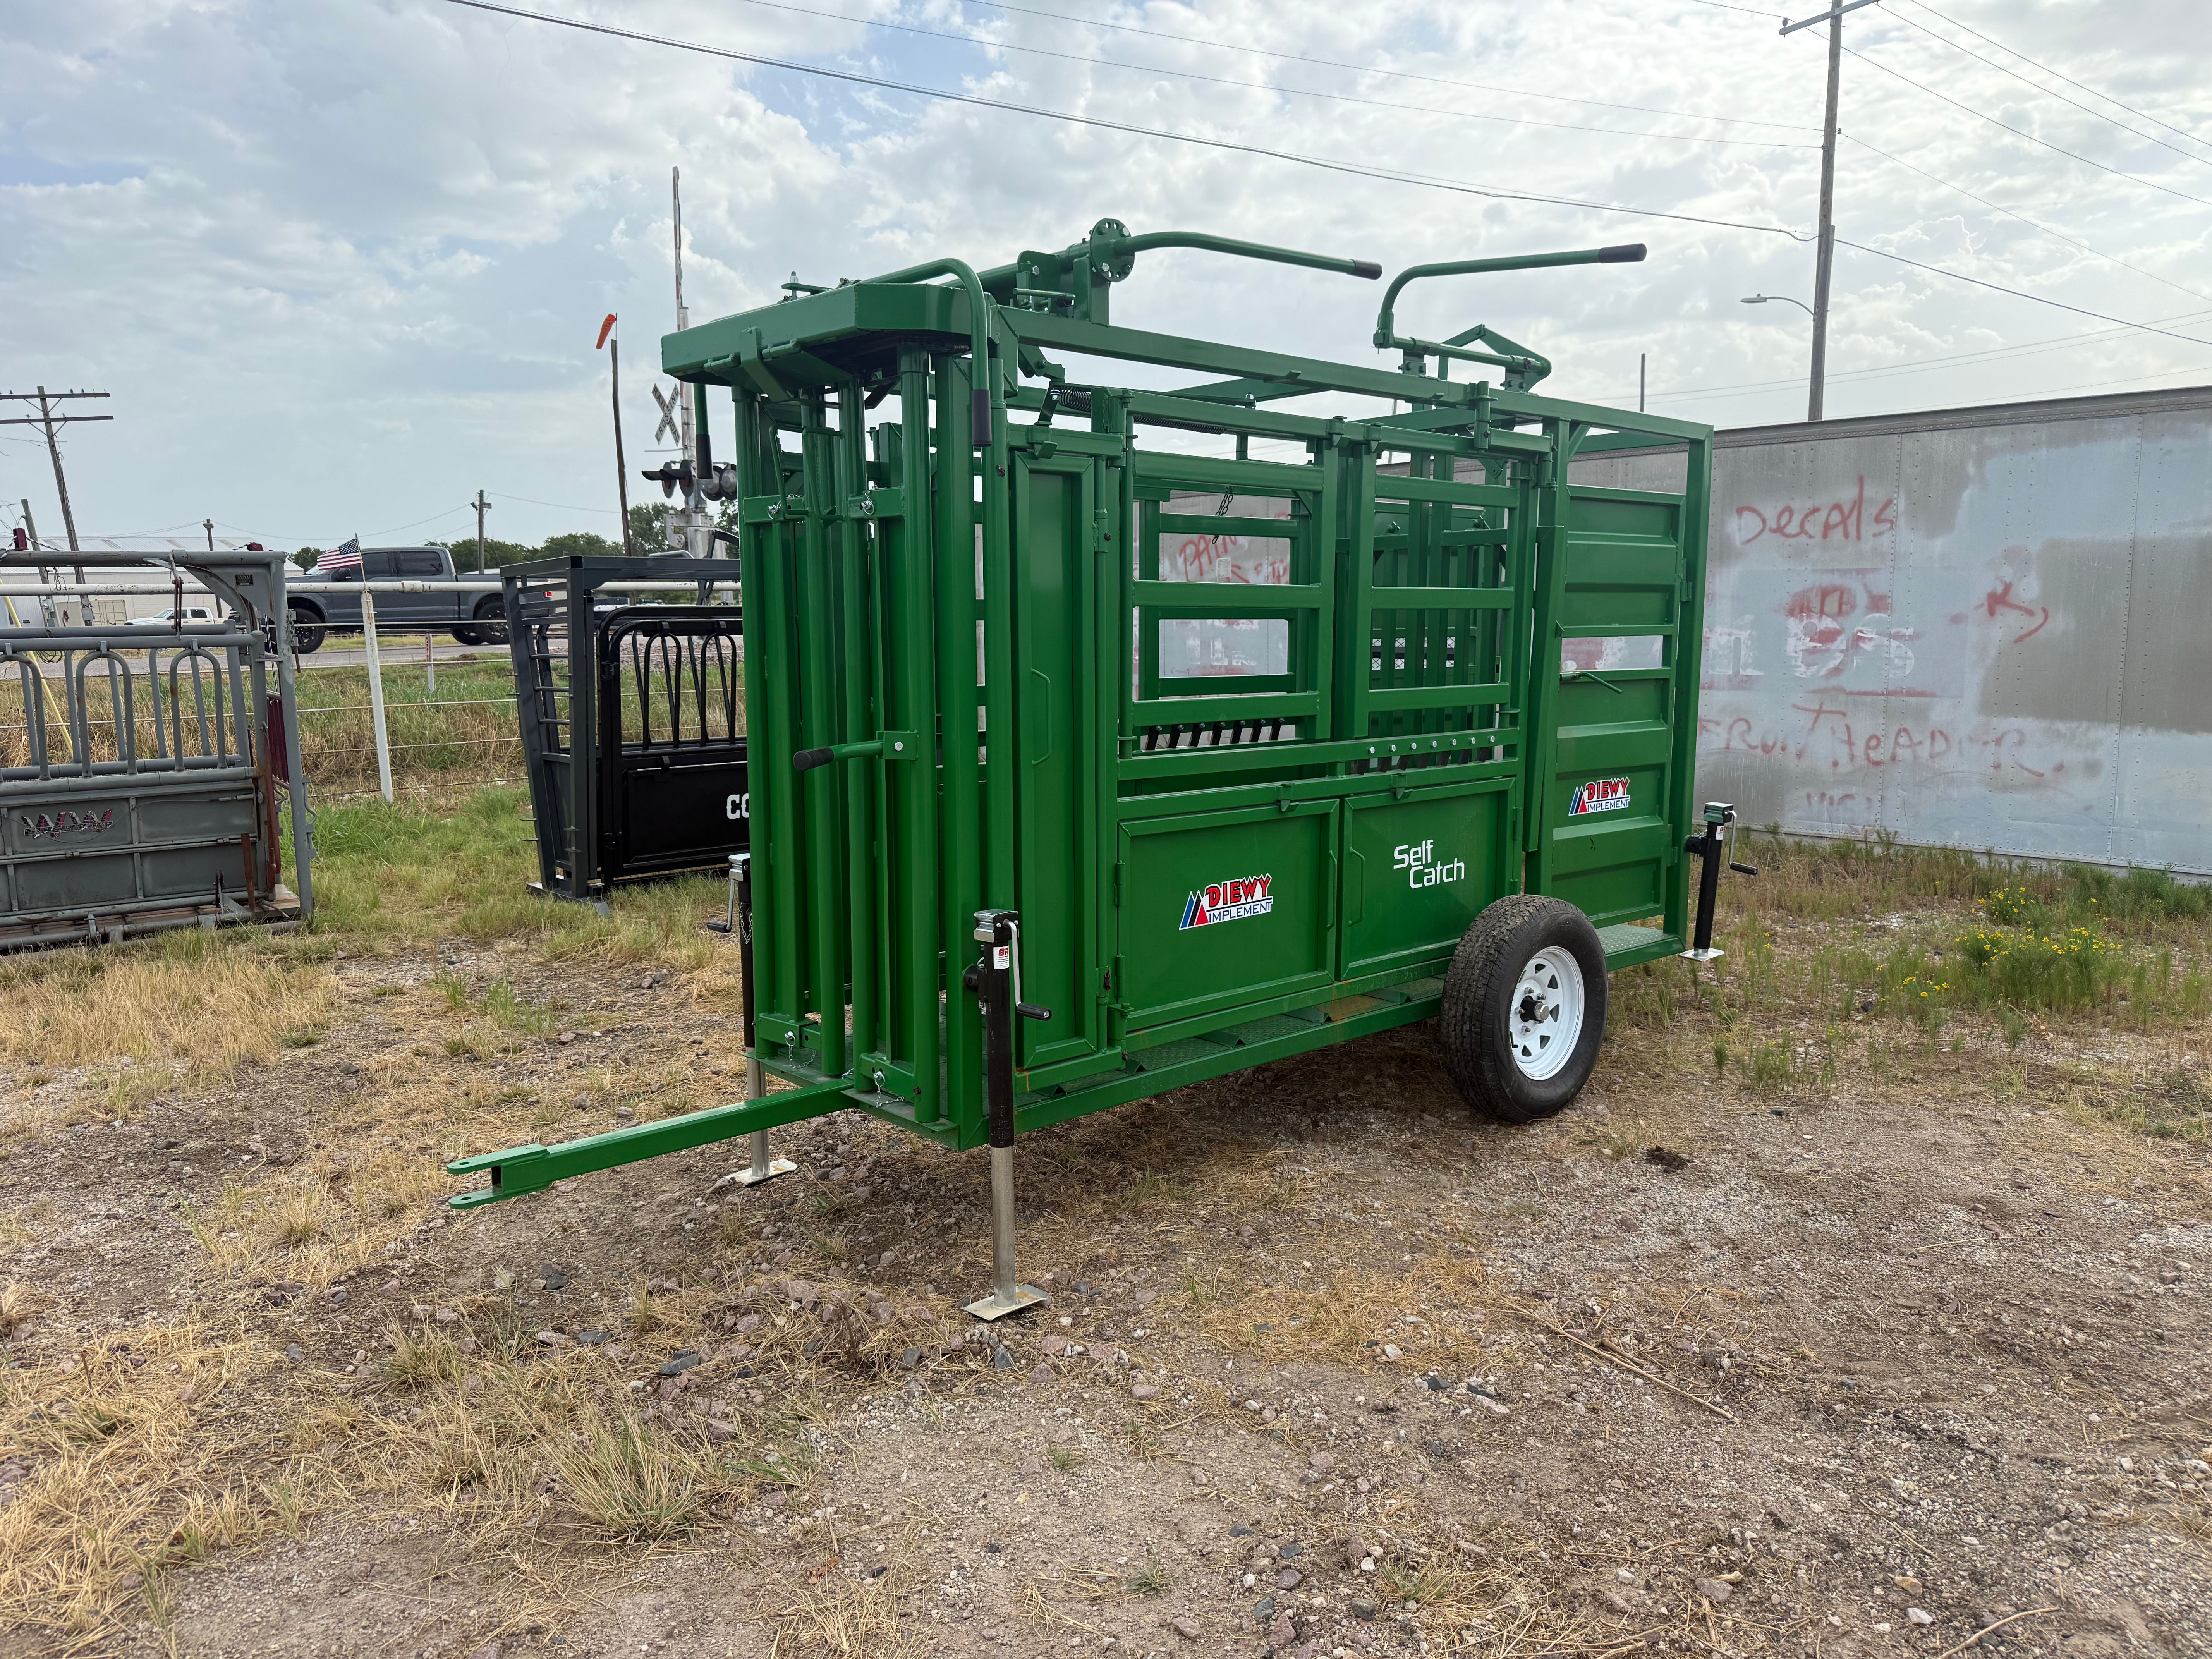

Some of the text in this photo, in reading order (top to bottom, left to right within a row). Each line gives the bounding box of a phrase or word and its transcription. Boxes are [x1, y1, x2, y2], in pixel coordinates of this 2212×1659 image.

[1585, 778, 1629, 800] DIEWY
[1587, 799, 1629, 812] IMPLEMENT
[1393, 839, 1434, 869] Self
[1409, 857, 1465, 889] Catch
[1205, 876, 1271, 908] DIEWY
[1209, 901, 1273, 923] IMPLEMENT
